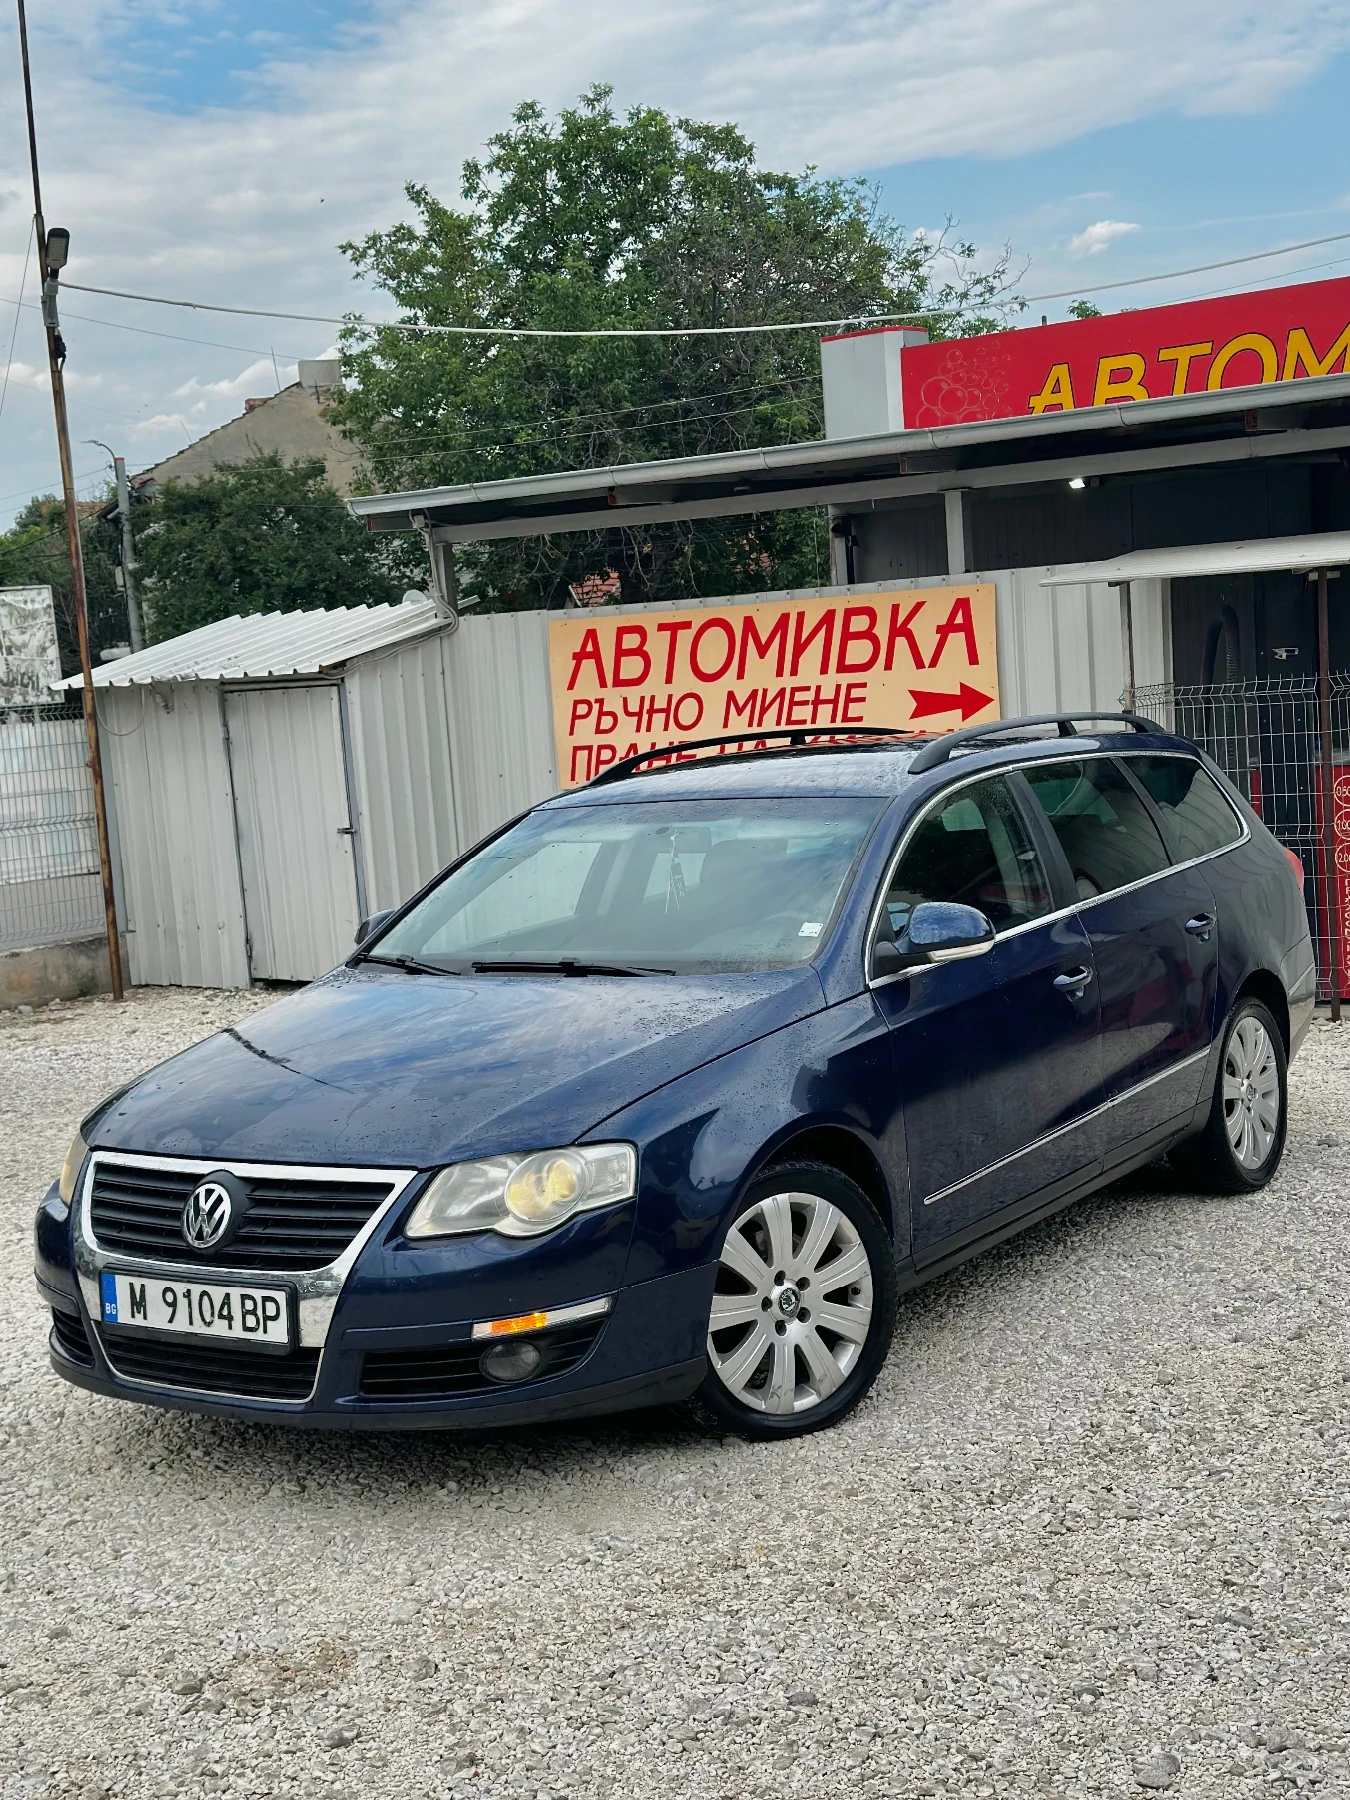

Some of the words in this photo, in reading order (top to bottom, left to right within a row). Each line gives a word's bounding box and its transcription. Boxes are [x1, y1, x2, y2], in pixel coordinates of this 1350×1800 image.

[566, 596, 980, 691] АВТОМИВКА
[568, 691, 704, 737] РЪЧНО
[722, 681, 869, 729] МИЕНЕ
[105, 1302, 117, 1315] BG
